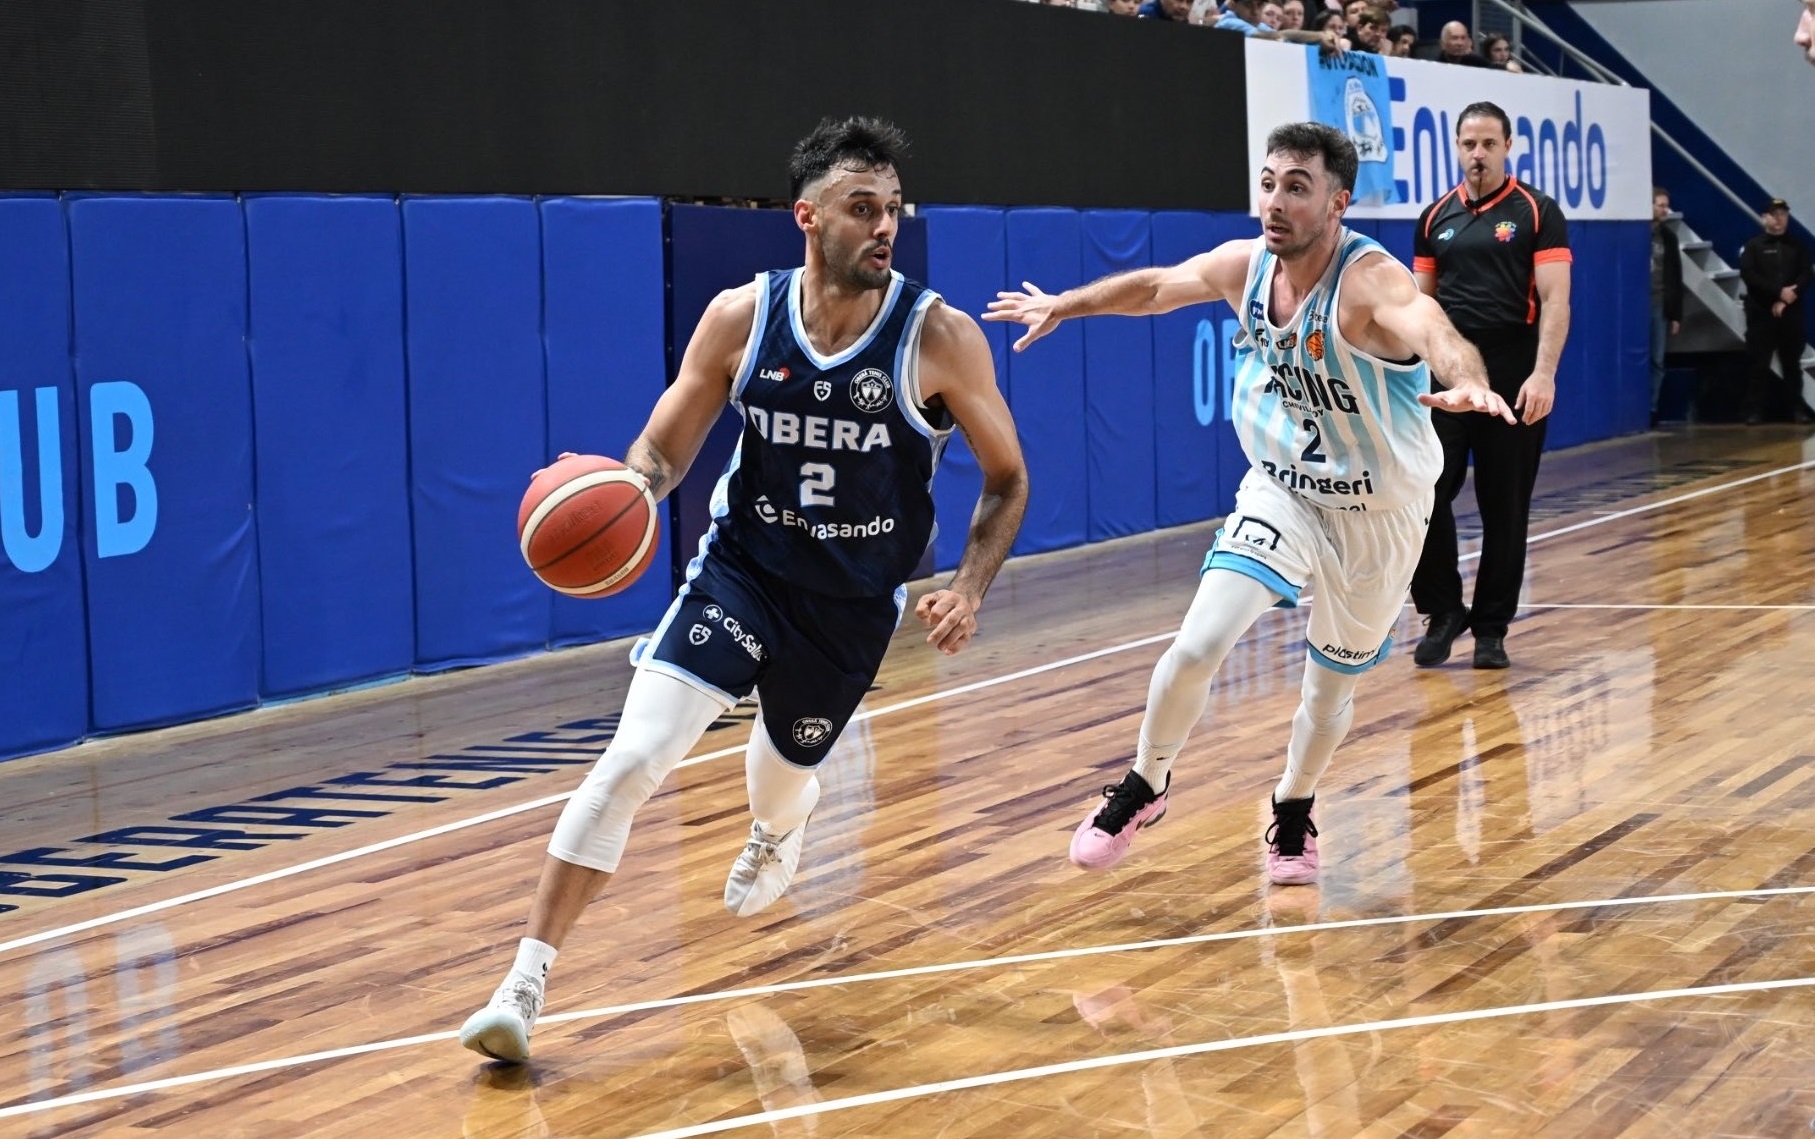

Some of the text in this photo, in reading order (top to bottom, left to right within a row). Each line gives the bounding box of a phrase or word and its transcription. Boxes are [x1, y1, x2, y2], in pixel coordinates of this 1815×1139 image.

[759, 368, 785, 382] LNB
[1300, 418, 1328, 463] 2
[799, 462, 836, 508] 2
[0, 804, 394, 914] BERA
